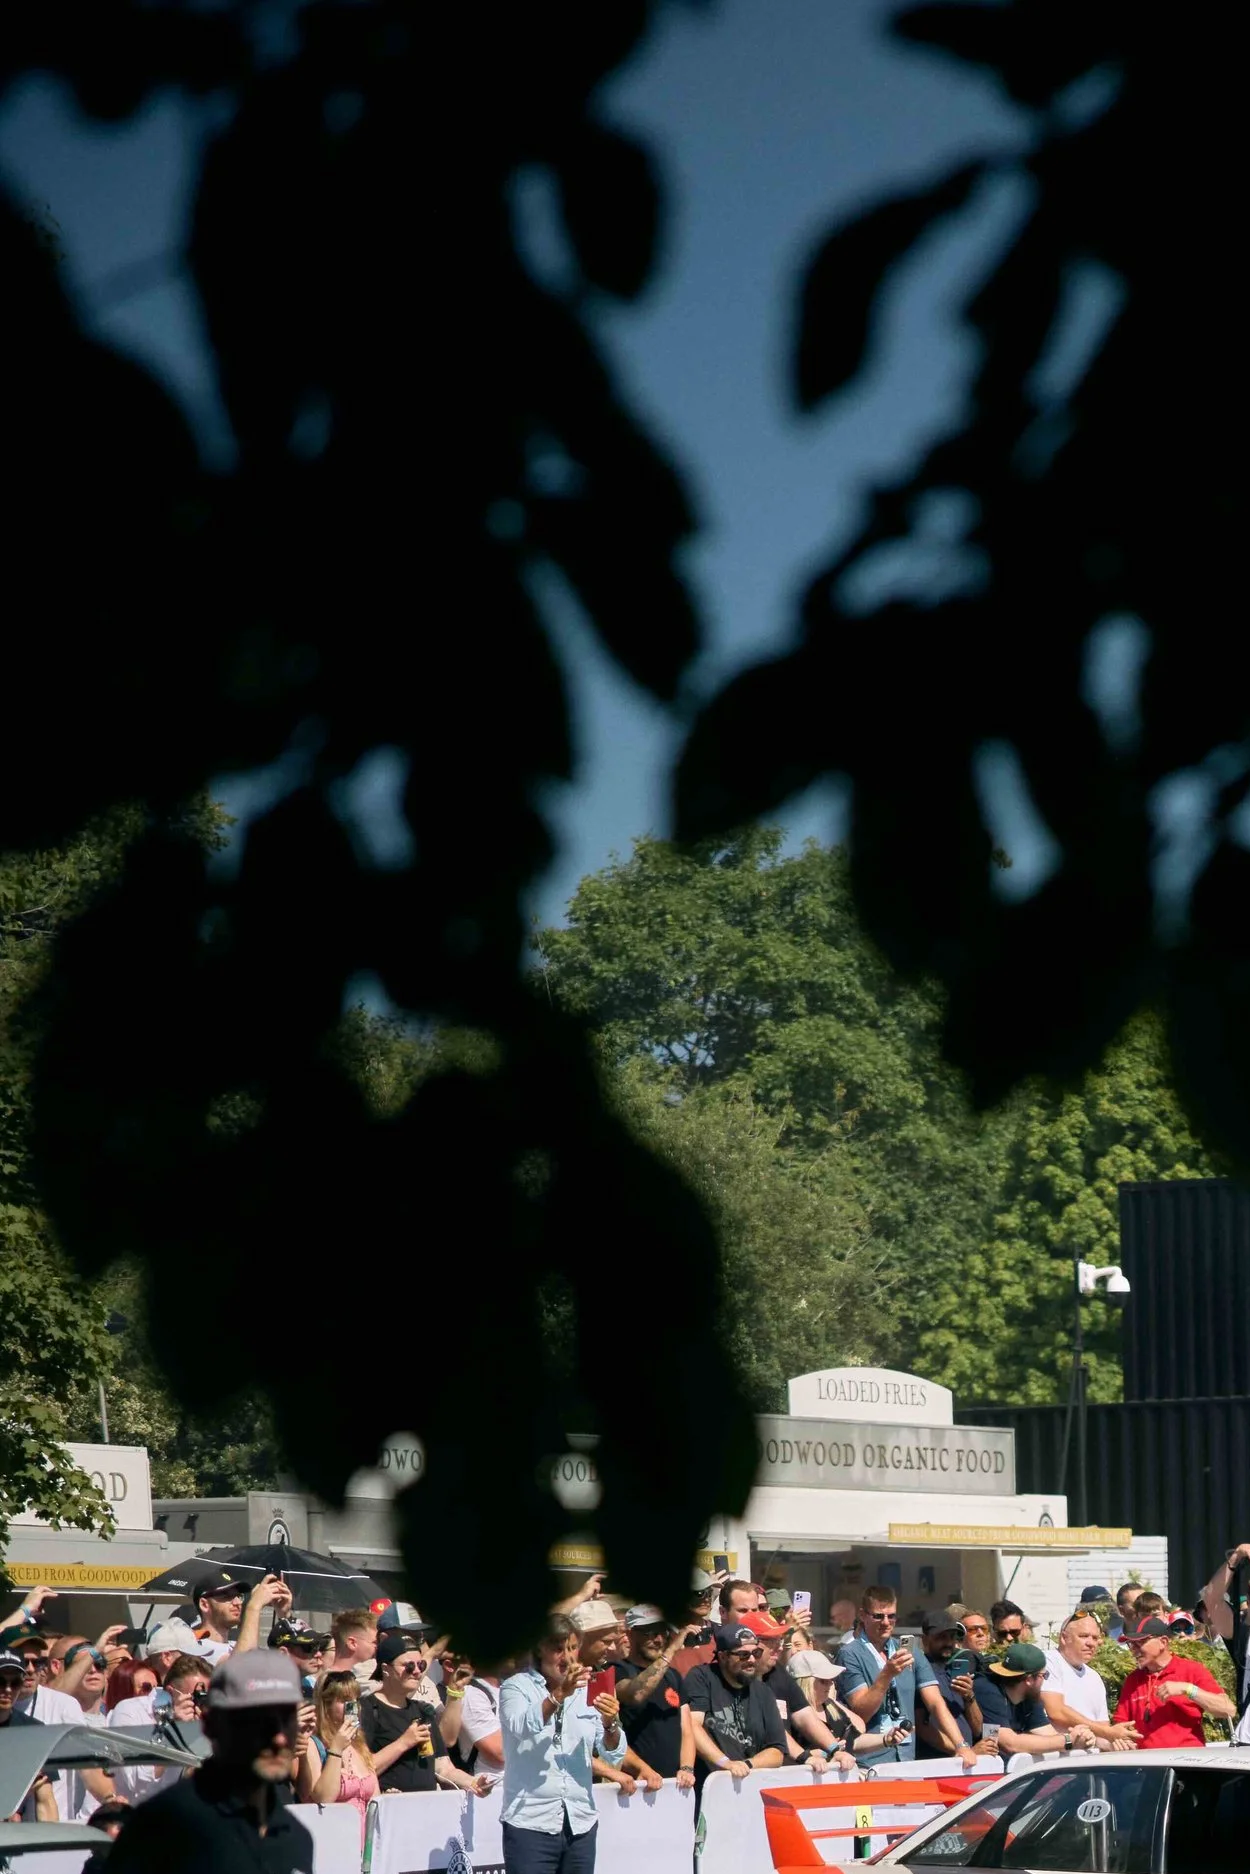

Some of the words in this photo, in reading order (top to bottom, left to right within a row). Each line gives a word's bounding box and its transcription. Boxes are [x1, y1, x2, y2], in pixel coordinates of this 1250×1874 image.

[818, 1378, 880, 1404] LOADED
[884, 1382, 927, 1407] FRIES
[862, 1443, 950, 1472] ORGANIC
[955, 1449, 1006, 1474] FOOD
[9, 1567, 41, 1580] RCED
[44, 1567, 76, 1581] FROM
[79, 1568, 147, 1583] GOODWOOD
[1083, 1805, 1102, 1818] 113
